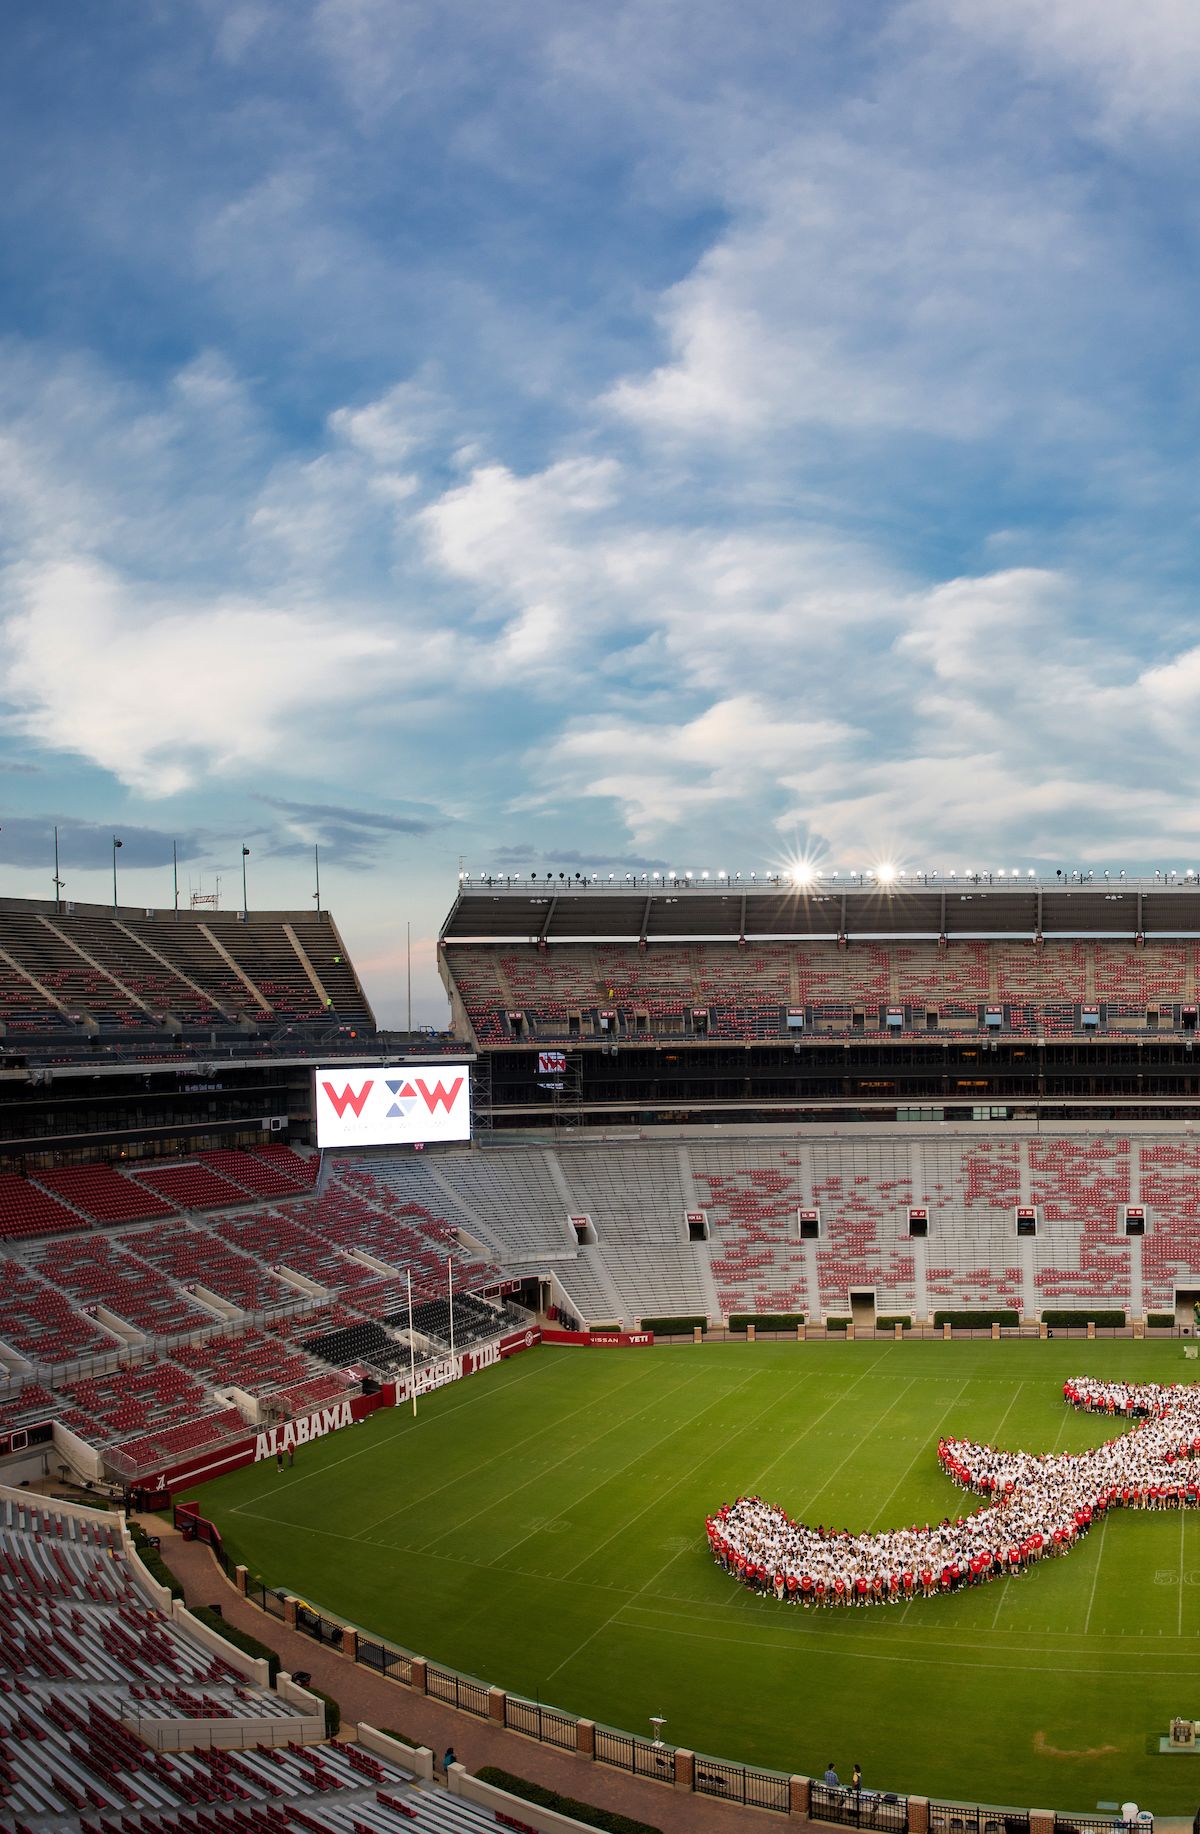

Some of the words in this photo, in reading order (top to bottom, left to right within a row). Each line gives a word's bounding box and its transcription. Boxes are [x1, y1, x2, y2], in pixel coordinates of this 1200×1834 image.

[629, 1335, 648, 1343] YETI
[395, 1355, 464, 1404] CRIMSON
[469, 1340, 502, 1372] TIDE
[254, 1400, 353, 1462] ALABAMA
